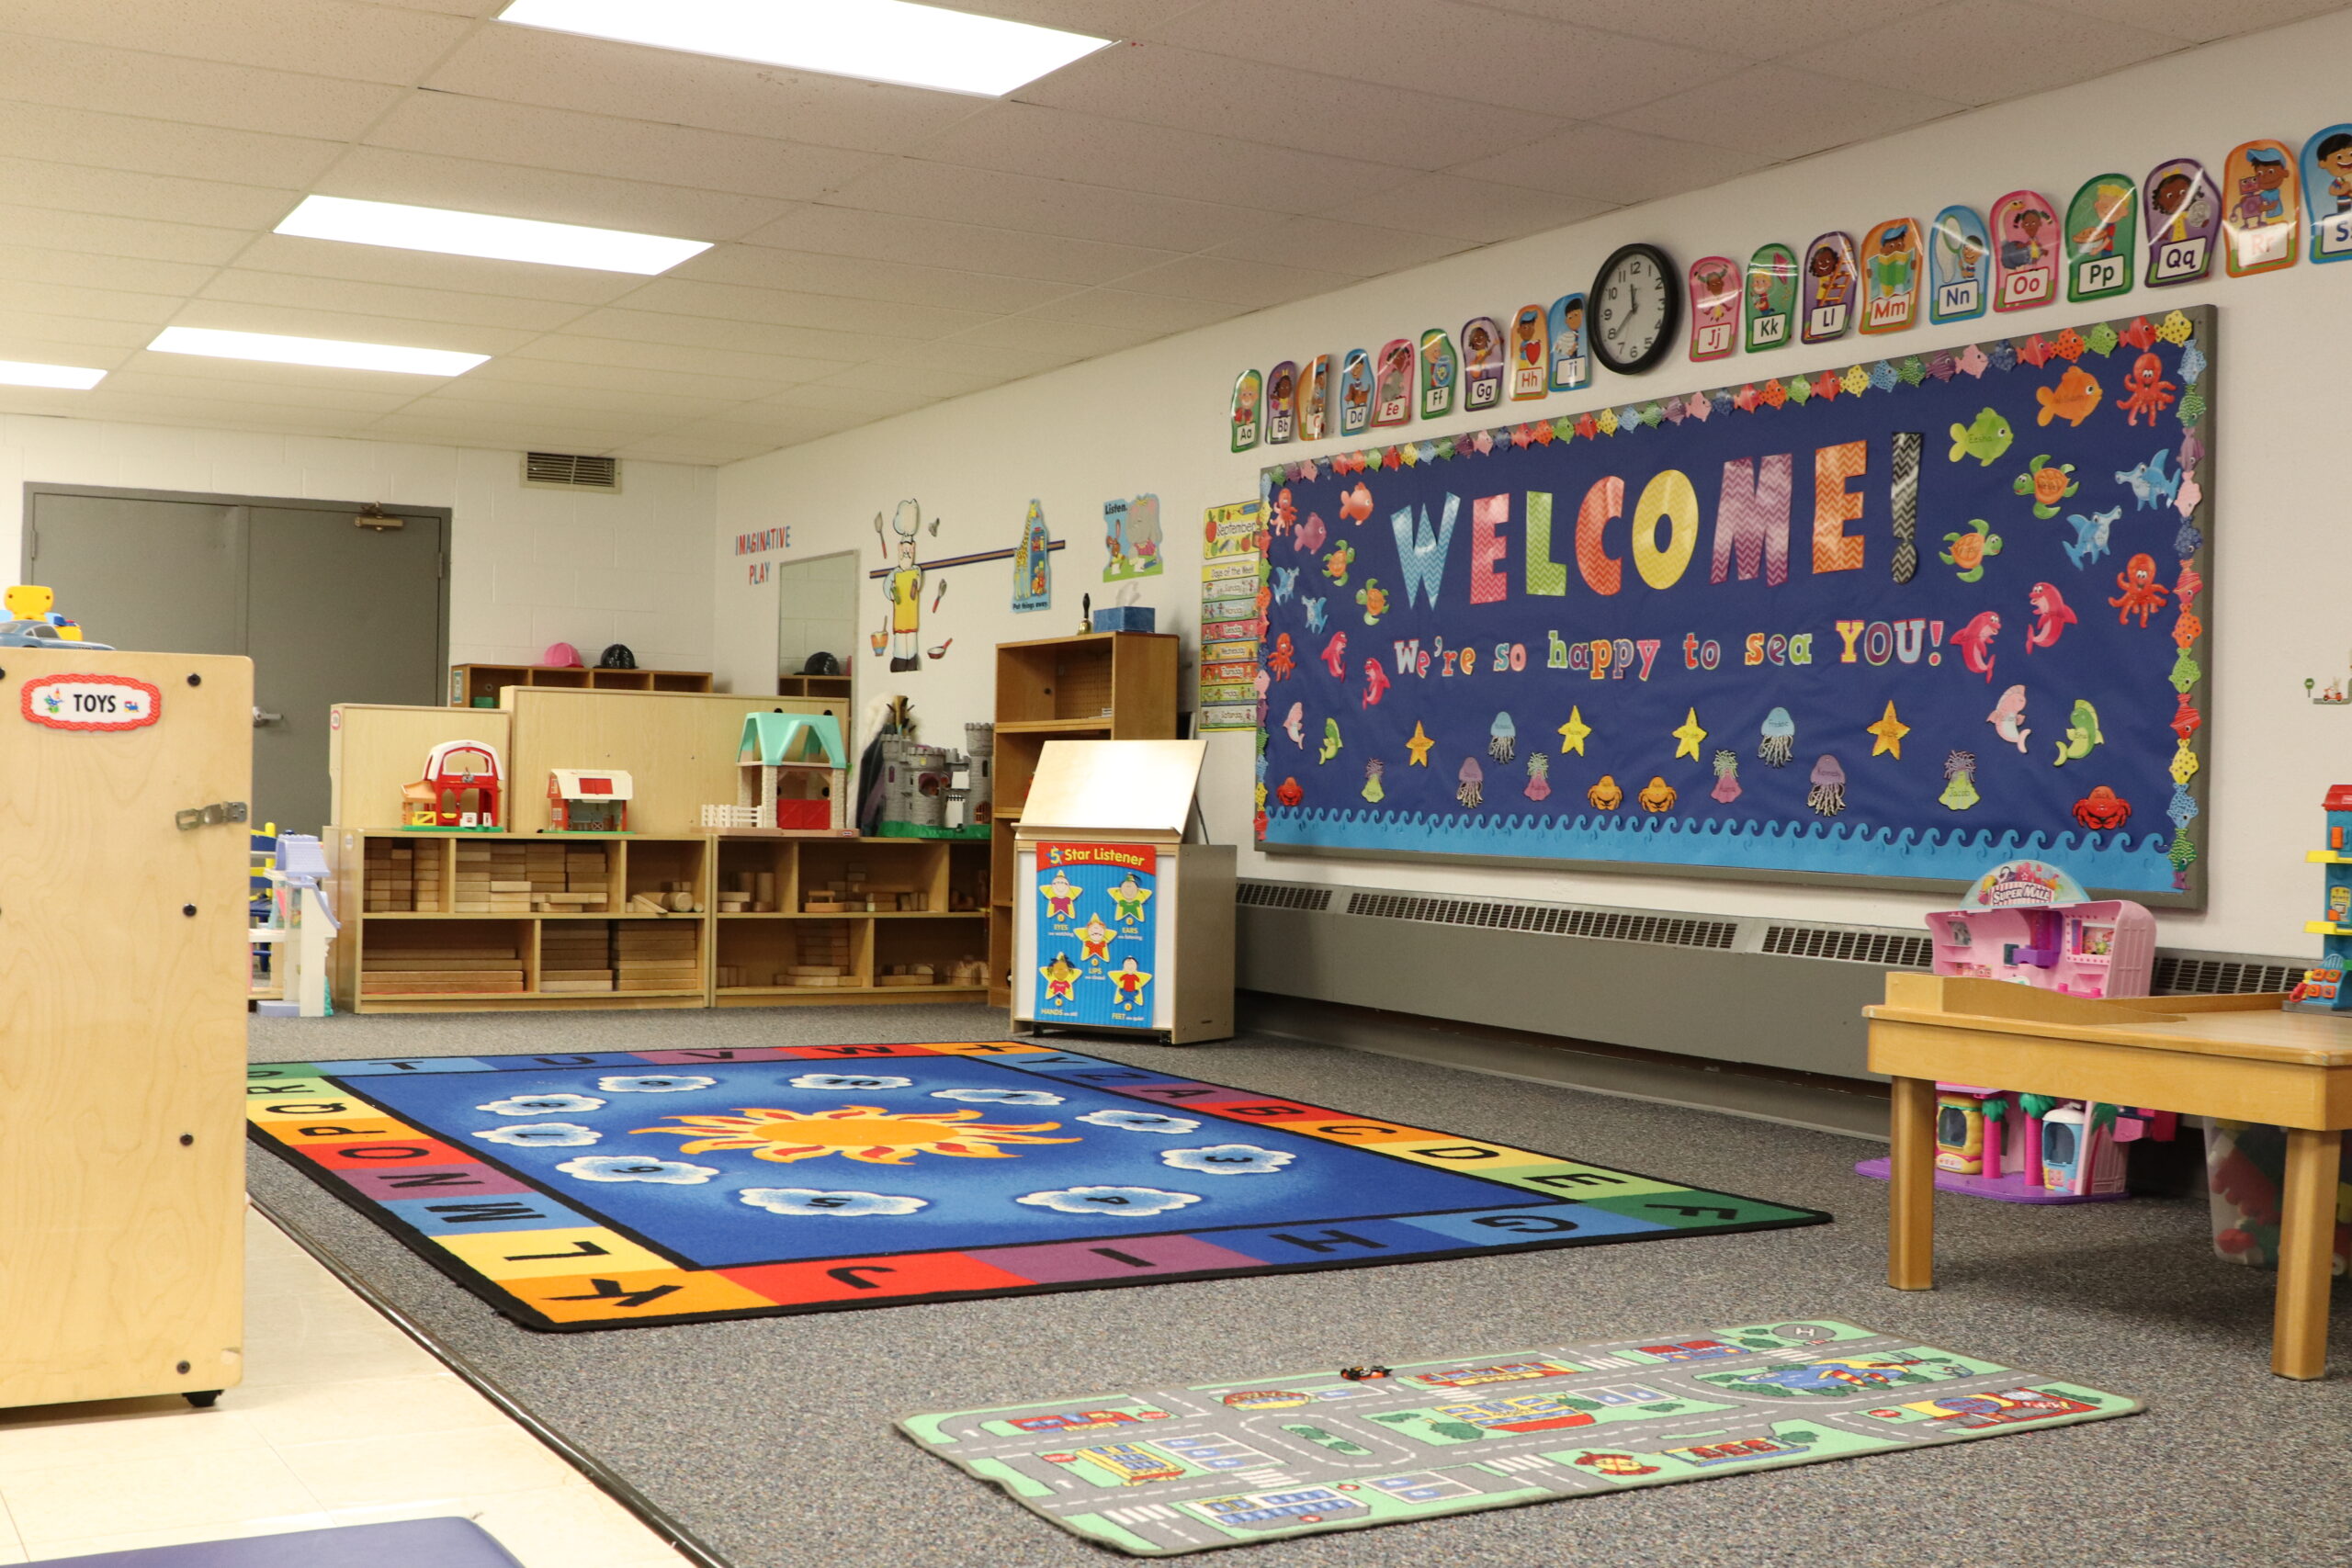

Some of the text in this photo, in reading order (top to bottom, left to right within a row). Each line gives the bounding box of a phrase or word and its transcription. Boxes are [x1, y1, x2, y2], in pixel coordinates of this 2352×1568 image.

[2251, 233, 2275, 254] Rr
[2166, 247, 2195, 270] Qq
[1618, 270, 1626, 283] 11
[1630, 262, 1641, 275] 12
[2090, 263, 2115, 287] Pp
[1655, 277, 1663, 290] 2
[2013, 276, 2041, 294] Oo
[1608, 287, 1618, 300] 10
[1946, 287, 1970, 307] Nn
[1657, 299, 1665, 310] 3
[1873, 299, 1905, 320] Mm
[1604, 309, 1612, 321] 9
[1822, 308, 1835, 327] Ll
[1654, 319, 1662, 330] 4
[1759, 319, 1778, 336] Kk
[1607, 328, 1616, 340] 8
[1707, 328, 1722, 351] Jj
[1617, 342, 1625, 355] 7
[1644, 337, 1654, 349] 5
[1630, 346, 1638, 358] 6
[1566, 361, 1577, 378] Ii
[1521, 372, 1538, 389] Hh
[1431, 391, 1442, 406] Ff
[1476, 383, 1492, 400] Gg
[1350, 408, 1363, 424] Dd
[1385, 402, 1399, 417] Ee
[1240, 427, 1252, 439] Aa
[1277, 420, 1289, 433] Bb
[1390, 432, 1925, 611] WELCOME!
[735, 525, 791, 557] IMAGINATIVE
[749, 561, 771, 586] PLAY
[1395, 618, 1945, 681] We're so happy to sea YOU!
[74, 694, 116, 713] TOYS
[1050, 848, 1145, 866] 5 Star Listener
[369, 1060, 423, 1070] T
[533, 1056, 595, 1066] U
[266, 1102, 347, 1114] Q
[1224, 1105, 1306, 1116] B
[298, 1125, 387, 1137] P
[1317, 1125, 1397, 1136] C
[338, 1145, 430, 1159] O
[1409, 1146, 1500, 1159] D
[377, 1172, 483, 1189] N
[1525, 1171, 1629, 1190] E
[1644, 1202, 1738, 1222] F
[1472, 1214, 1578, 1234] G
[1269, 1228, 1389, 1253] H
[503, 1240, 611, 1262] L
[826, 1265, 897, 1291] J
[539, 1278, 685, 1308] K
[1795, 1327, 1815, 1336] H
